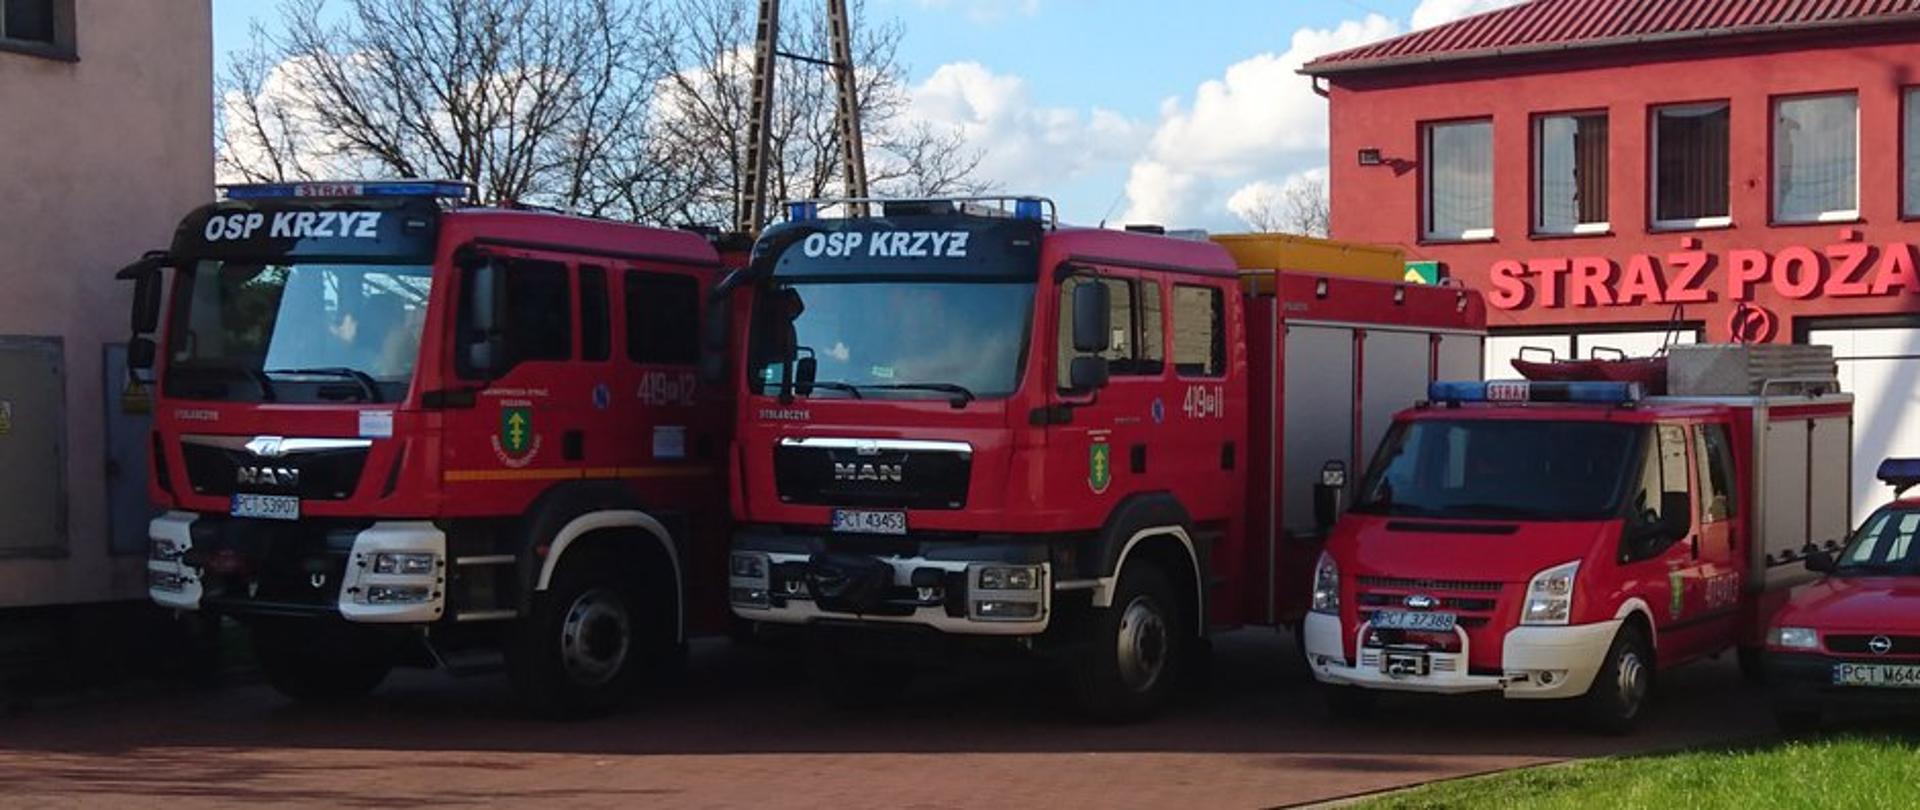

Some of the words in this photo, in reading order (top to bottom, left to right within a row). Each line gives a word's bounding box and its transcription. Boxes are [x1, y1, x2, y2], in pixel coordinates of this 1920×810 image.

[204, 213, 264, 241] OSP
[803, 232, 863, 257] OSP
[1488, 236, 1716, 309] STRAŻ
[237, 466, 299, 485] MAN
[834, 462, 903, 482] MAN
[262, 497, 297, 514] 53907
[866, 512, 904, 529] 43453
[1410, 613, 1453, 630] 37388
[1841, 665, 1877, 680] PCT
